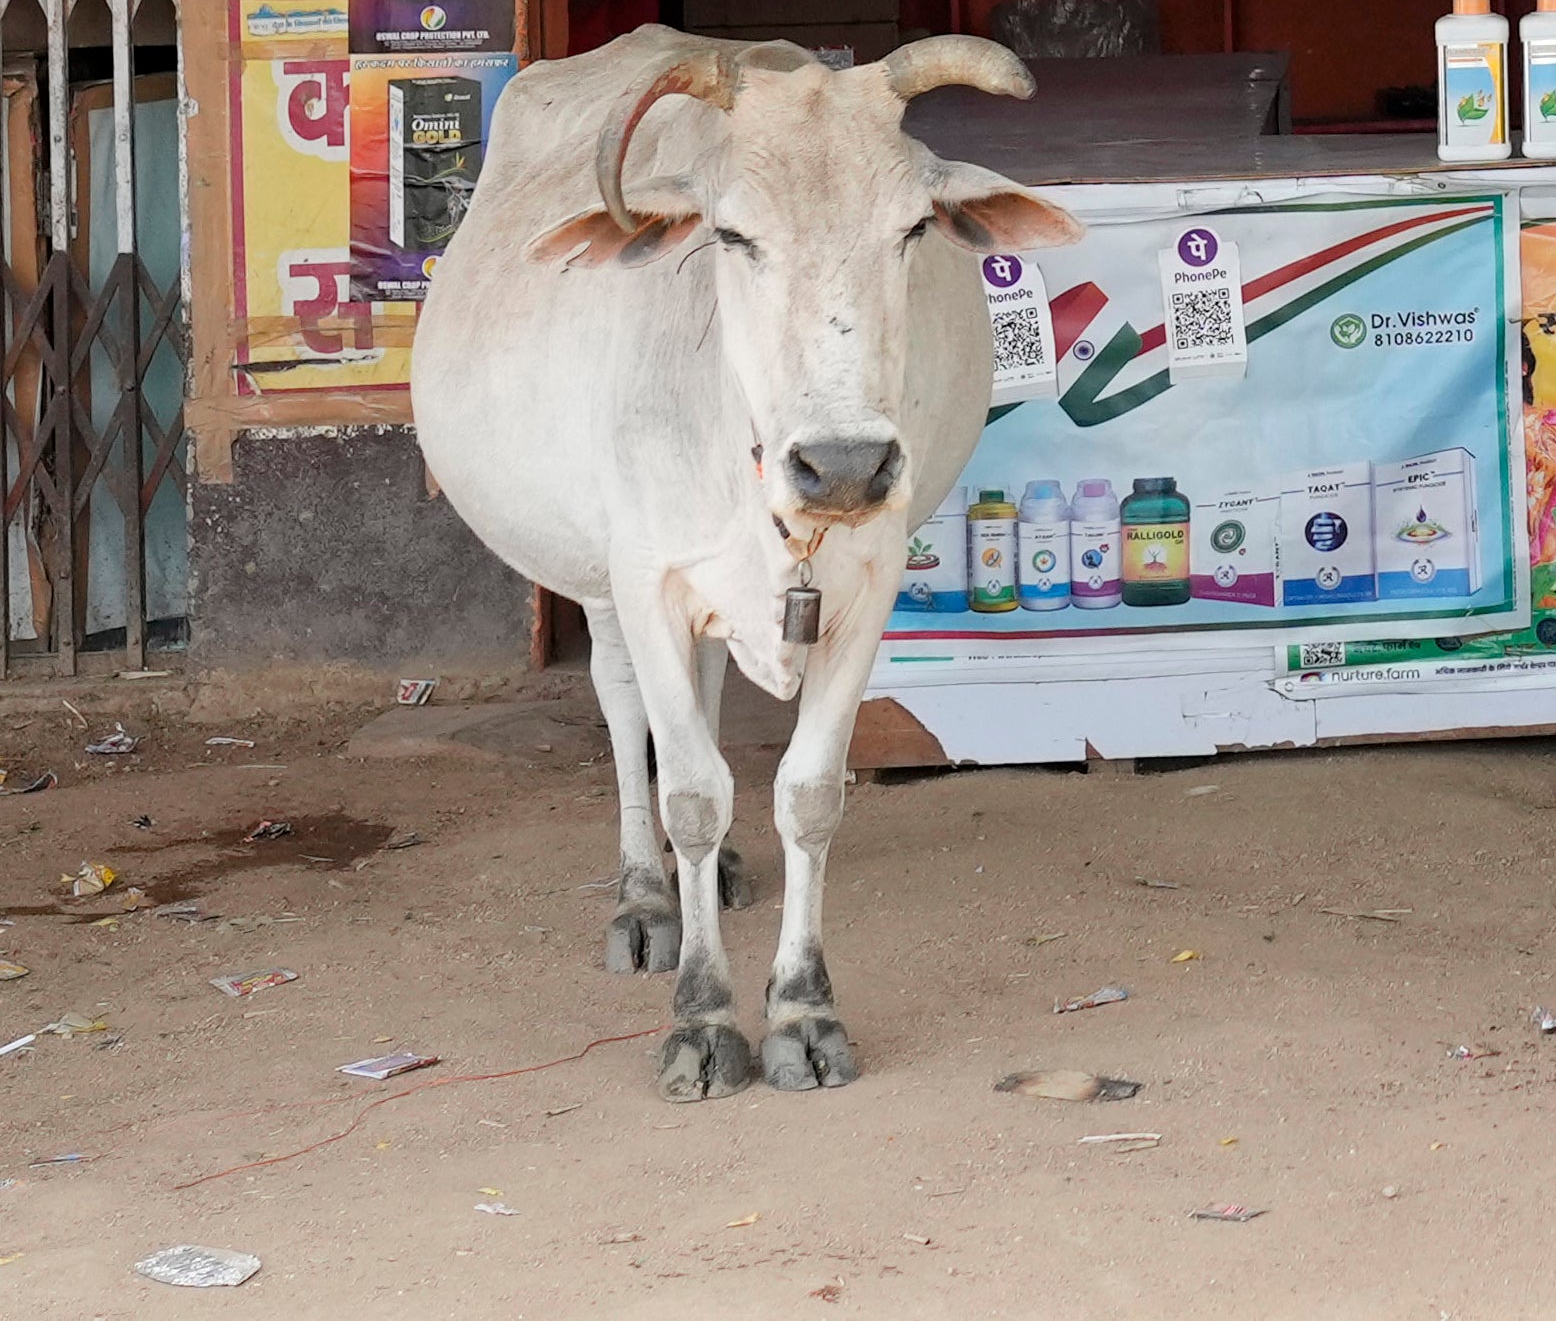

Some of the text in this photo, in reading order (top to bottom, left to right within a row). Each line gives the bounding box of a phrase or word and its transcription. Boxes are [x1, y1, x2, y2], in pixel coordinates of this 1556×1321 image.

[412, 118, 460, 131] Omini
[413, 130, 461, 145] GOLD
[1188, 233, 1208, 260] पे
[992, 257, 1011, 282] पे
[1175, 269, 1227, 283] PhonePe
[988, 289, 1033, 304] honePe
[1374, 329, 1474, 346] 8108622210
[1408, 472, 1429, 483] EPIC
[1308, 483, 1340, 494] TAQAT
[1127, 530, 1184, 541] RALLIGOLD
[1331, 667, 1420, 682] nurture.farm
